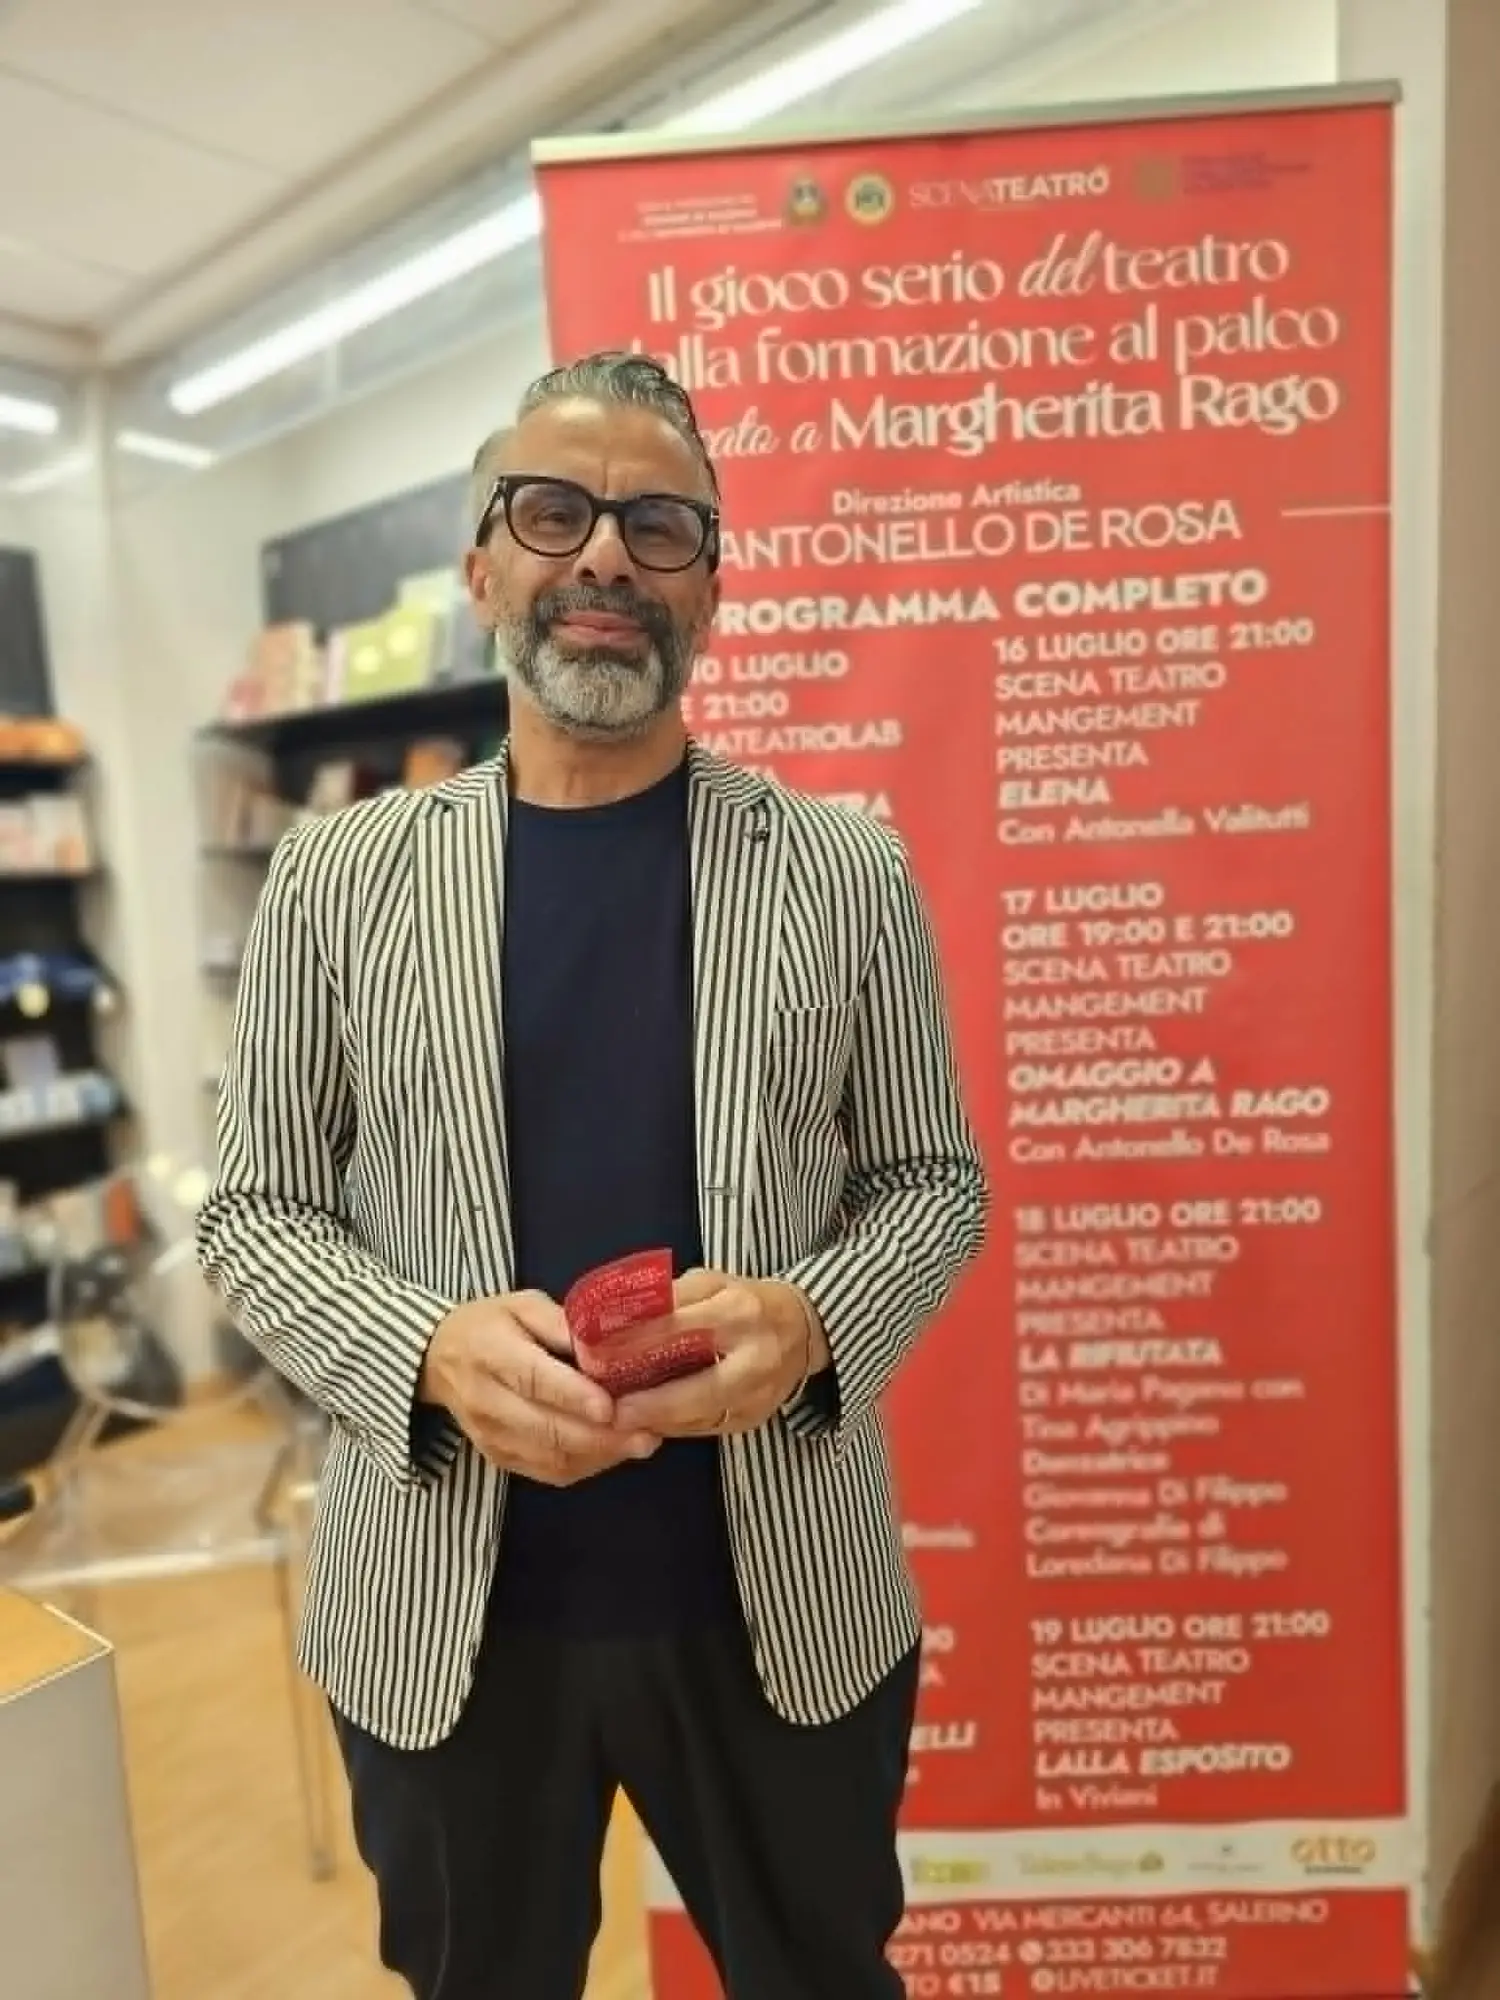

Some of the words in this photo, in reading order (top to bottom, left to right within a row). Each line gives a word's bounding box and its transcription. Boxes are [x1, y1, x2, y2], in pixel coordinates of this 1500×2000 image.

[649, 265, 677, 323] Il
[689, 265, 849, 331] gioco
[862, 249, 1004, 310] serio
[1018, 229, 1102, 298] del
[1103, 233, 1290, 294] teatro
[755, 318, 1096, 385] formazione
[1108, 302, 1158, 365] al
[1173, 294, 1340, 376] palco
[829, 380, 1164, 457] Margherita
[1178, 373, 1341, 436] Rago
[832, 487, 963, 516] Direzione
[969, 479, 1082, 508] Artistica
[719, 512, 1016, 571] ANTONELLO
[1024, 509, 1094, 553] DE
[1101, 499, 1243, 549] ROSA
[1013, 568, 1268, 618] COMPLETO
[993, 635, 1028, 663] 16
[1037, 629, 1148, 662] LUGLIO
[1156, 624, 1220, 654] ORE
[1229, 618, 1314, 651] 21:00
[731, 651, 850, 682] LUGLIO
[995, 668, 1101, 701] SCENA
[1109, 661, 1228, 694] TEATRO
[703, 690, 790, 720] 21:00
[995, 700, 1202, 736] MANGEMENT
[996, 740, 1150, 774] PRESENTA
[998, 776, 1112, 810] ELENA
[997, 818, 1056, 845] Con
[1002, 888, 1036, 915] 17
[1044, 882, 1164, 914] LUGLIO
[1002, 923, 1068, 951] ORE
[1079, 918, 1166, 948] 19:00
[1203, 910, 1294, 940] 21:00
[1003, 956, 1108, 986] SCENA
[1116, 948, 1233, 981] TEATRO
[1003, 987, 1209, 1022] MANGEMENT
[1005, 1025, 1158, 1056] PRESENTA
[1007, 1059, 1183, 1093] OMAGGIO
[1188, 1057, 1217, 1085] A
[1009, 1093, 1221, 1128] MARGHERITA
[1230, 1087, 1331, 1119] RAGO
[1009, 1136, 1066, 1164] Con
[1213, 1128, 1253, 1157] De
[1053, 1202, 1161, 1232] LUGLIO
[1168, 1199, 1231, 1228] ORE
[1239, 1196, 1322, 1226] 21:00
[1014, 1238, 1119, 1269] SCENA
[1125, 1235, 1240, 1265] TEATRO
[1016, 1306, 1166, 1336] PRESENTA
[1018, 1344, 1060, 1373] LA
[1031, 1618, 1062, 1646] 19
[1070, 1613, 1174, 1643] LUGLIO
[1183, 1613, 1243, 1641] ORE
[1252, 1610, 1330, 1639] 21:00
[1030, 1650, 1134, 1680] SCENA
[1138, 1646, 1251, 1676] TEATRO
[1031, 1680, 1227, 1713] MANGEMENT
[1033, 1714, 1180, 1745] PRESENTA
[1035, 1748, 1131, 1778] LALLA
[1138, 1742, 1292, 1775] ESPOSITO
